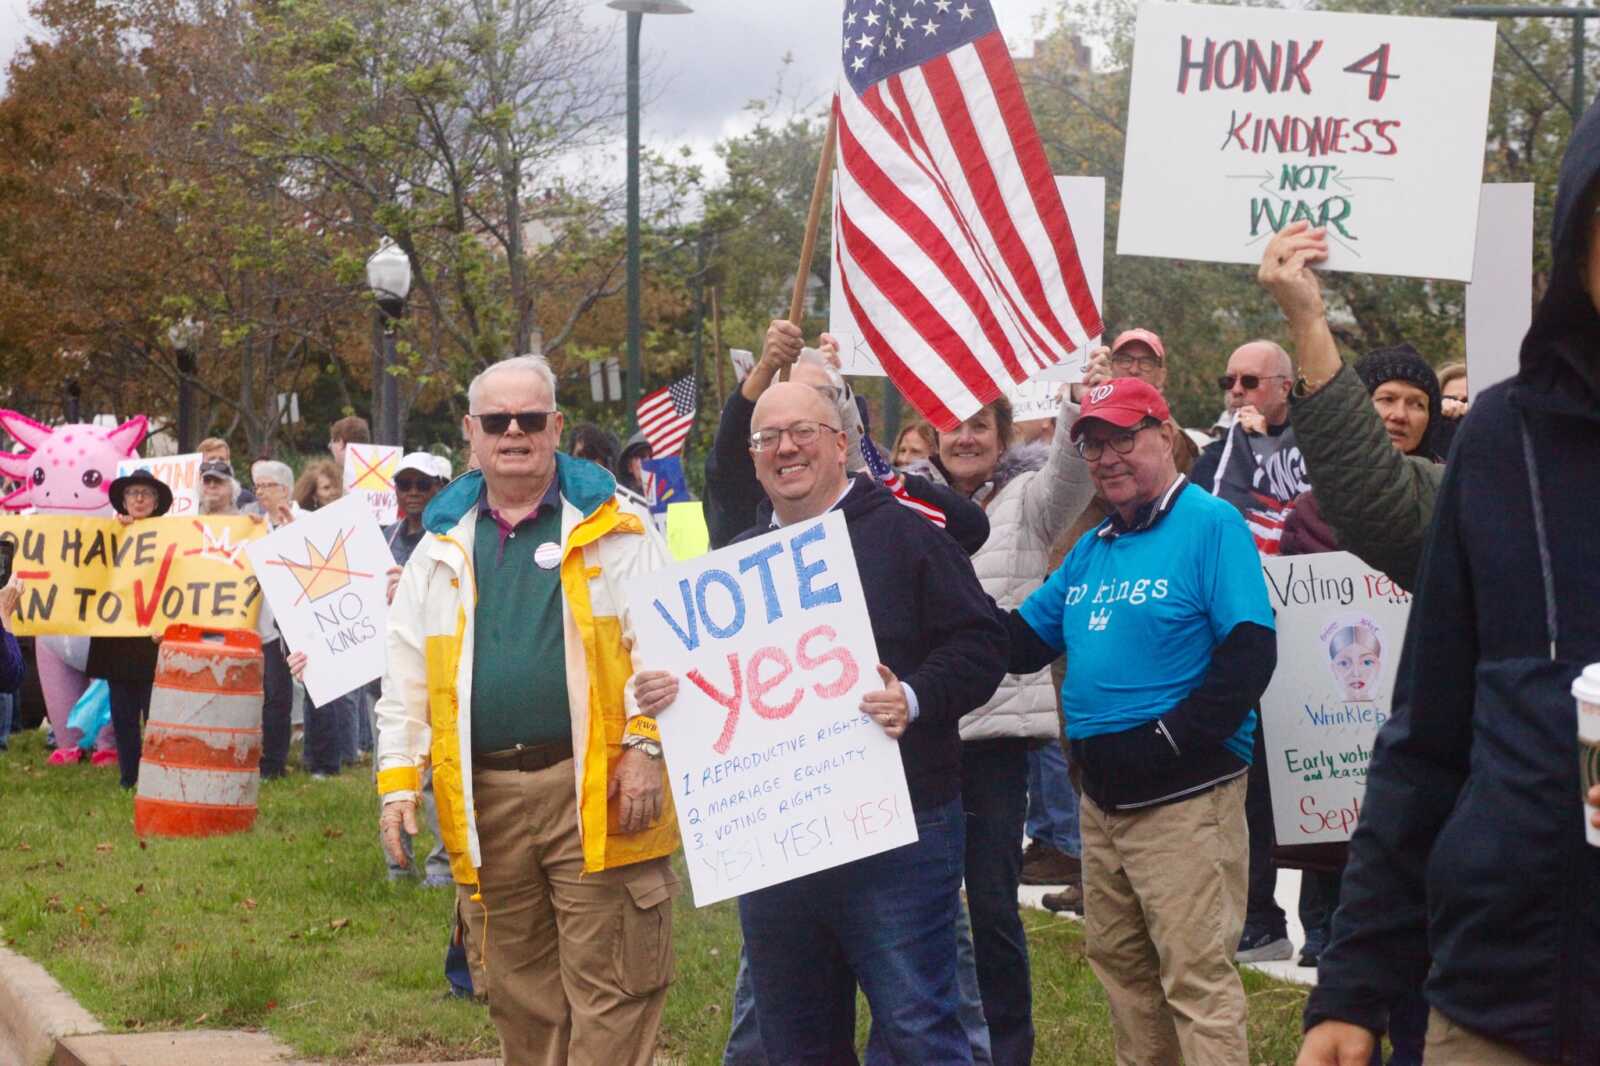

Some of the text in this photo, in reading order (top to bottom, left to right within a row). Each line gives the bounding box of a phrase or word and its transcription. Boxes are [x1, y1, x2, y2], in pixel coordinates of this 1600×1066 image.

[1177, 35, 1401, 102] HONK 4
[1221, 110, 1401, 157] KINDNESS
[1278, 164, 1337, 191] NOT
[1250, 196, 1358, 240] WAR
[61, 528, 158, 568] HAVE
[74, 588, 122, 624] TO
[133, 543, 261, 627] VOTE?
[653, 522, 842, 651] VOTE
[1092, 578, 1169, 605] kings
[1263, 563, 1354, 607] Voting
[314, 592, 363, 633] NO
[325, 616, 377, 656] KINGS
[702, 734, 807, 787] REPRODUCTIVE
[817, 714, 871, 742] RIGHTS
[1284, 748, 1333, 777] Early
[708, 777, 783, 817] MARRIAGE
[794, 746, 867, 781] EQUALITY
[1303, 769, 1323, 782] and
[715, 807, 768, 841] VOTING
[778, 784, 832, 814] RIGHTS
[703, 794, 903, 884] YES! YES! YES!
